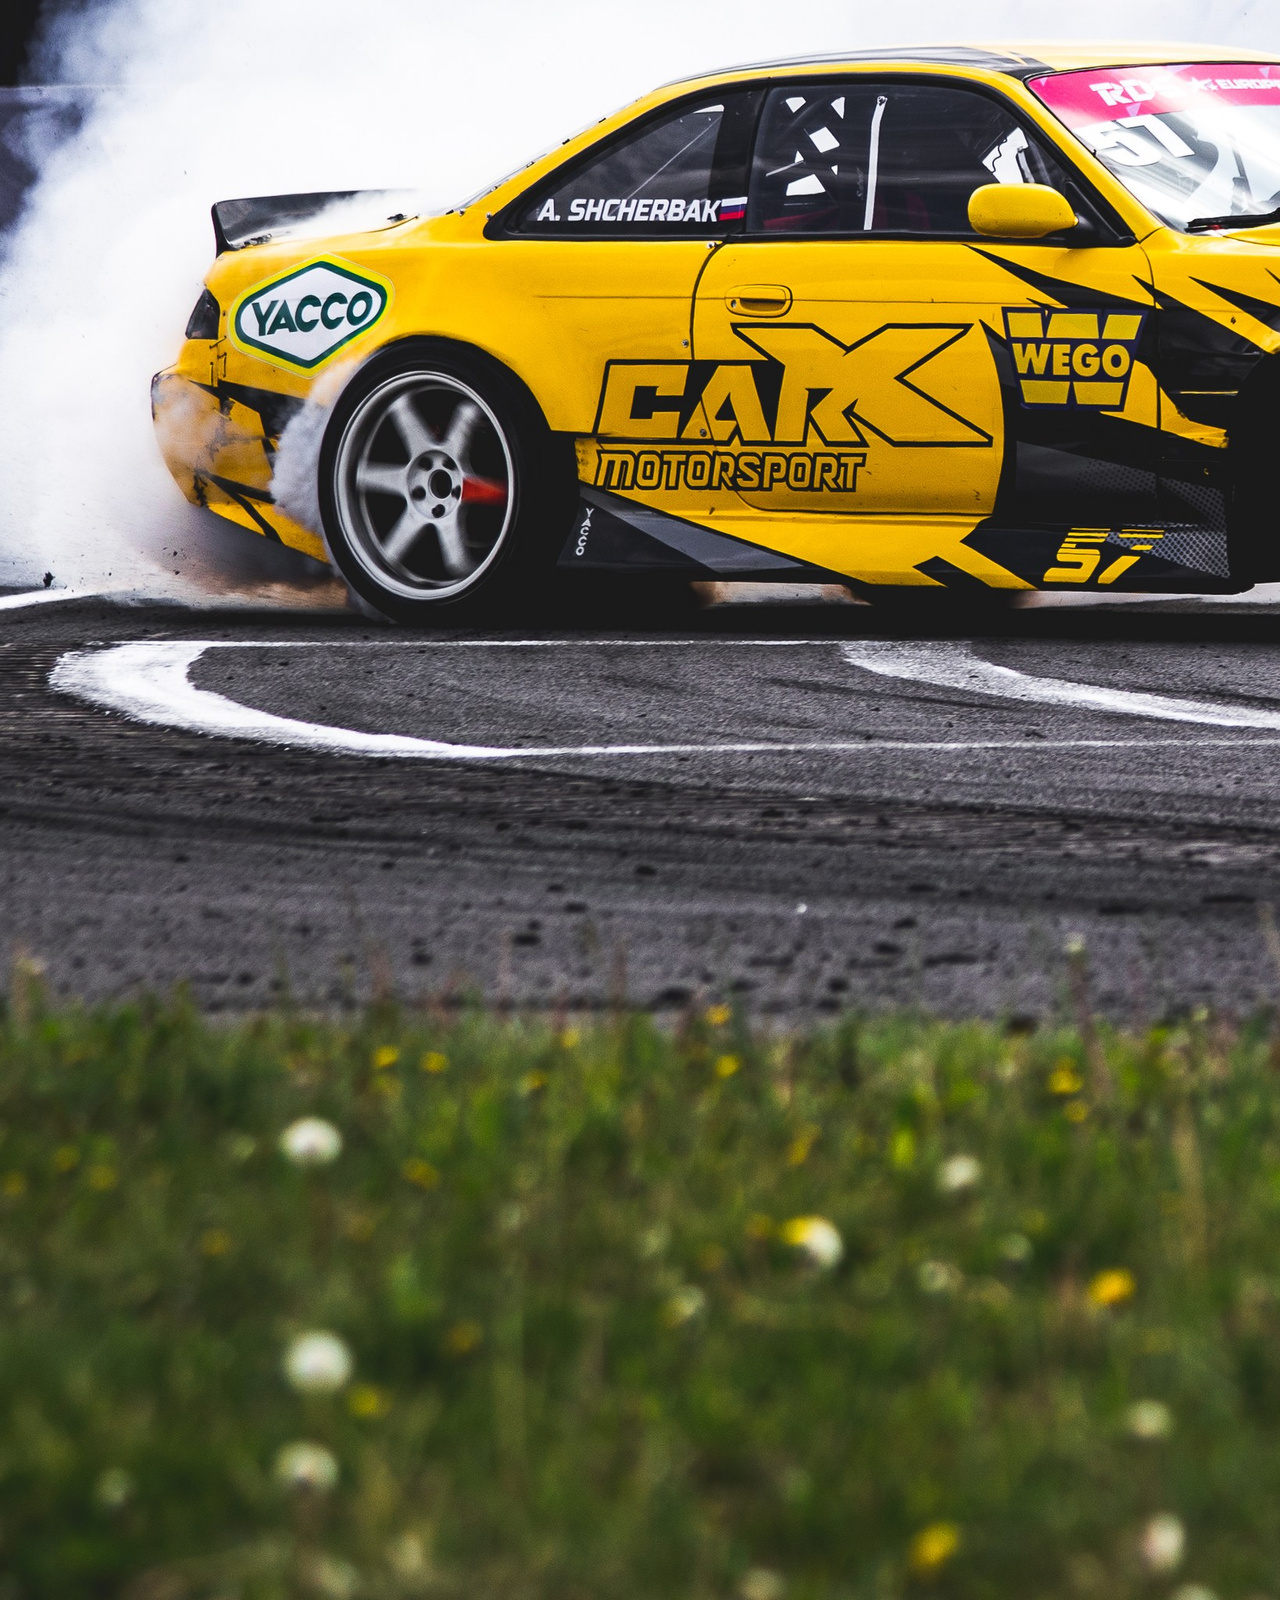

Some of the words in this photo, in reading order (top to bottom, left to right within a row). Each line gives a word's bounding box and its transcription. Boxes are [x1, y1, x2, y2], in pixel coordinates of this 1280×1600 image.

[1088, 79, 1178, 106] RD
[1073, 114, 1196, 167] 57
[537, 199, 560, 221] A.
[567, 199, 722, 222] SHCHERBAK
[251, 291, 373, 337] YACCO
[1012, 343, 1130, 378] WEGO
[596, 449, 867, 493] MOTORSPORT
[575, 507, 595, 556] YACCO
[1043, 527, 1165, 585] 57
